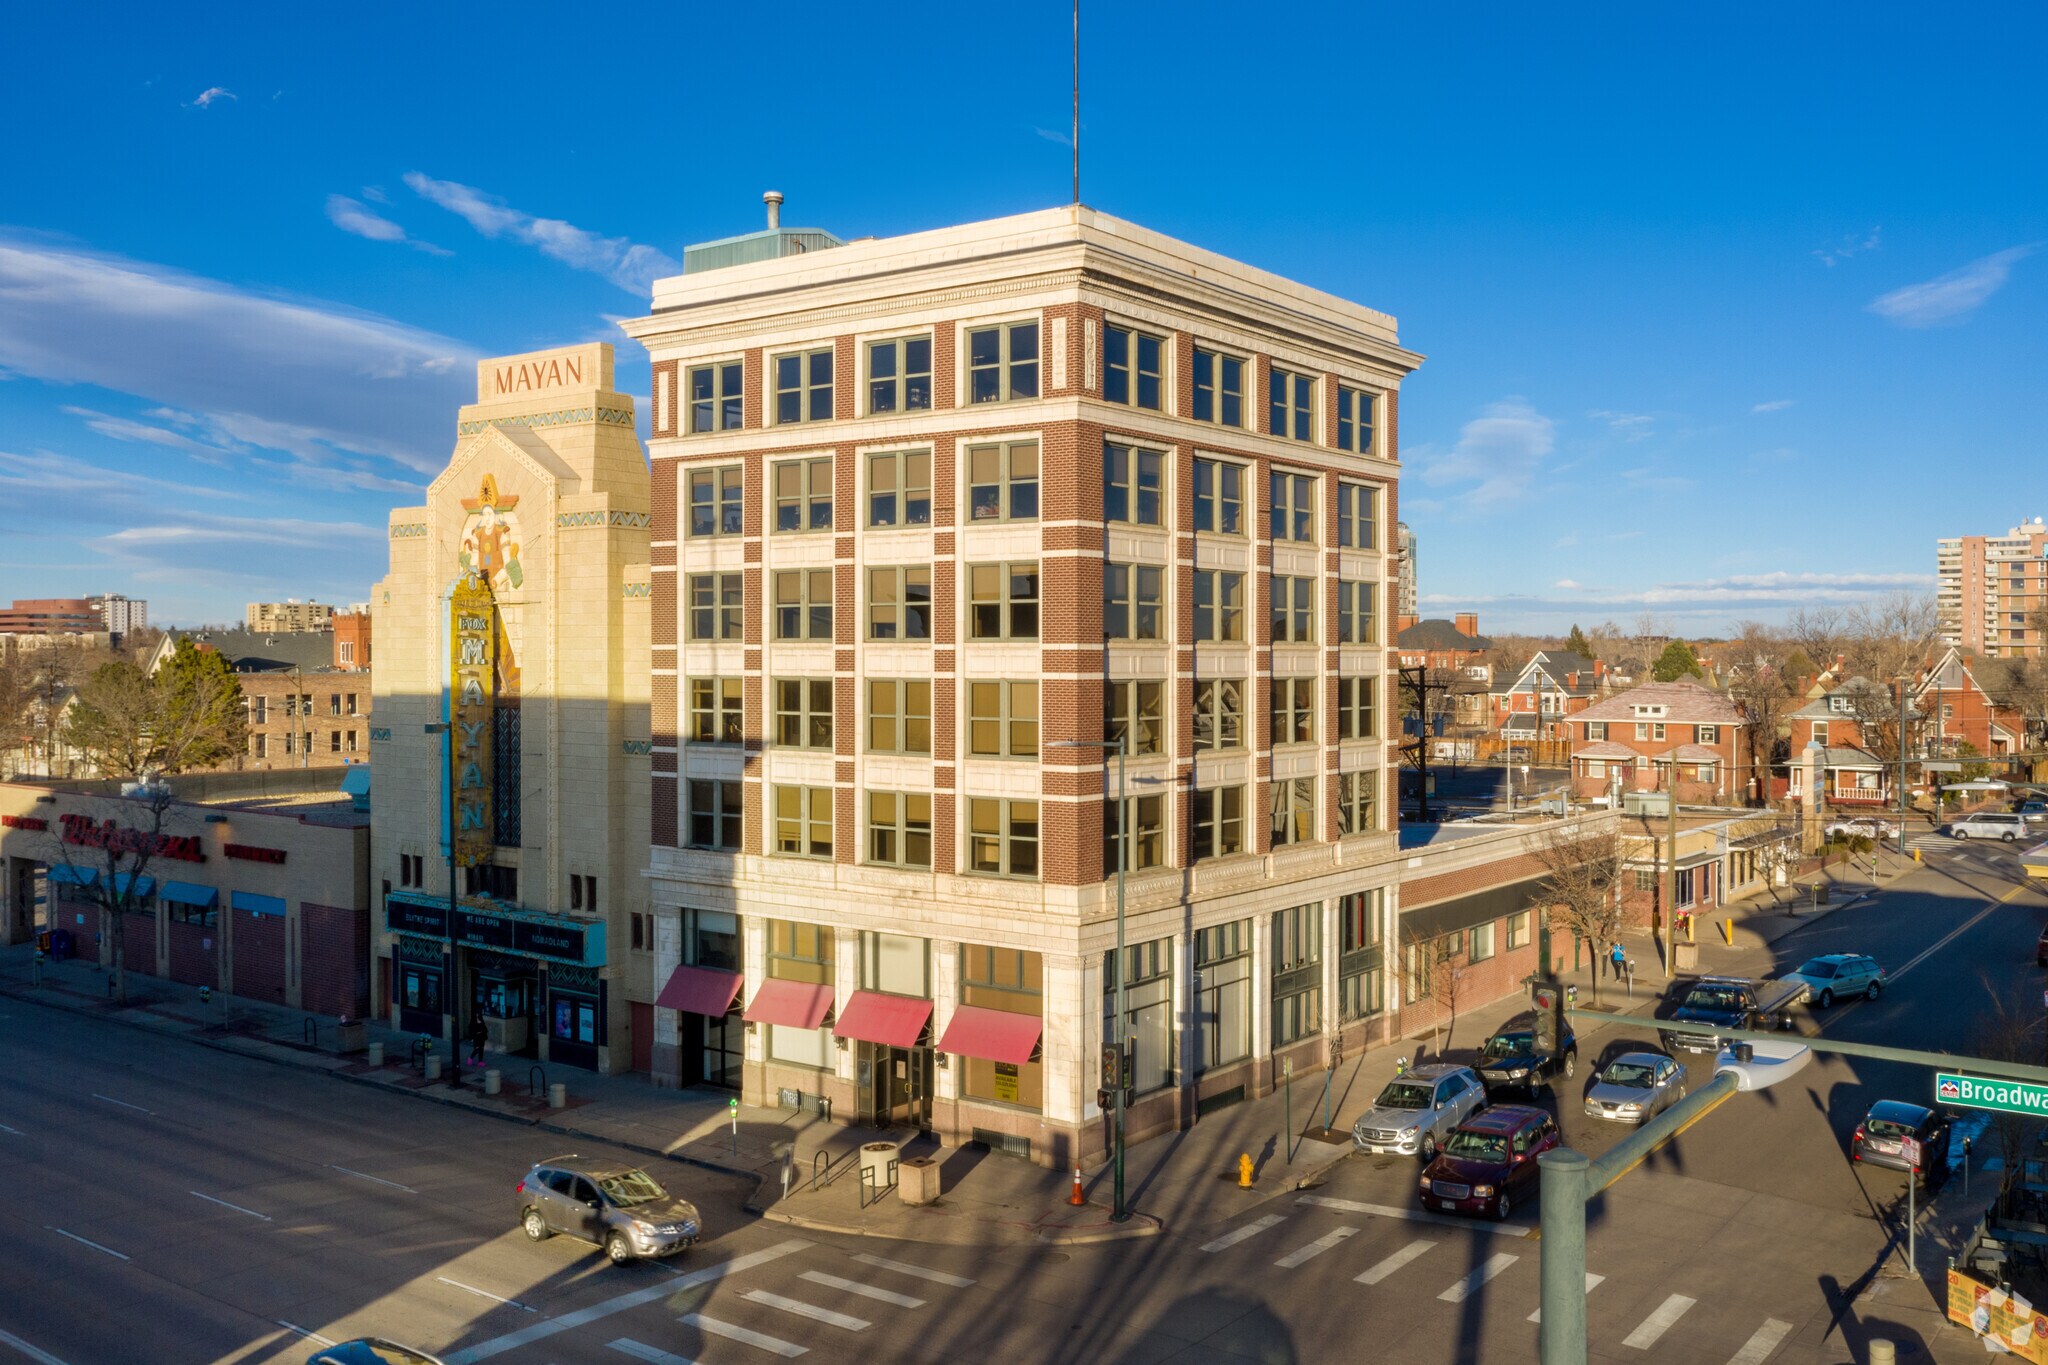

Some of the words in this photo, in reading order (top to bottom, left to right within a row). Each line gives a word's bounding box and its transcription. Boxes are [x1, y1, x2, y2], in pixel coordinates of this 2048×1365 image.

[496, 356, 581, 394] MAYAN
[459, 617, 486, 631] FOX
[459, 638, 486, 831] MAYAN
[466, 915, 474, 923] WE
[474, 916, 485, 926] ARE
[486, 918, 500, 928] OPEN
[531, 934, 570, 949] NOMADLAND
